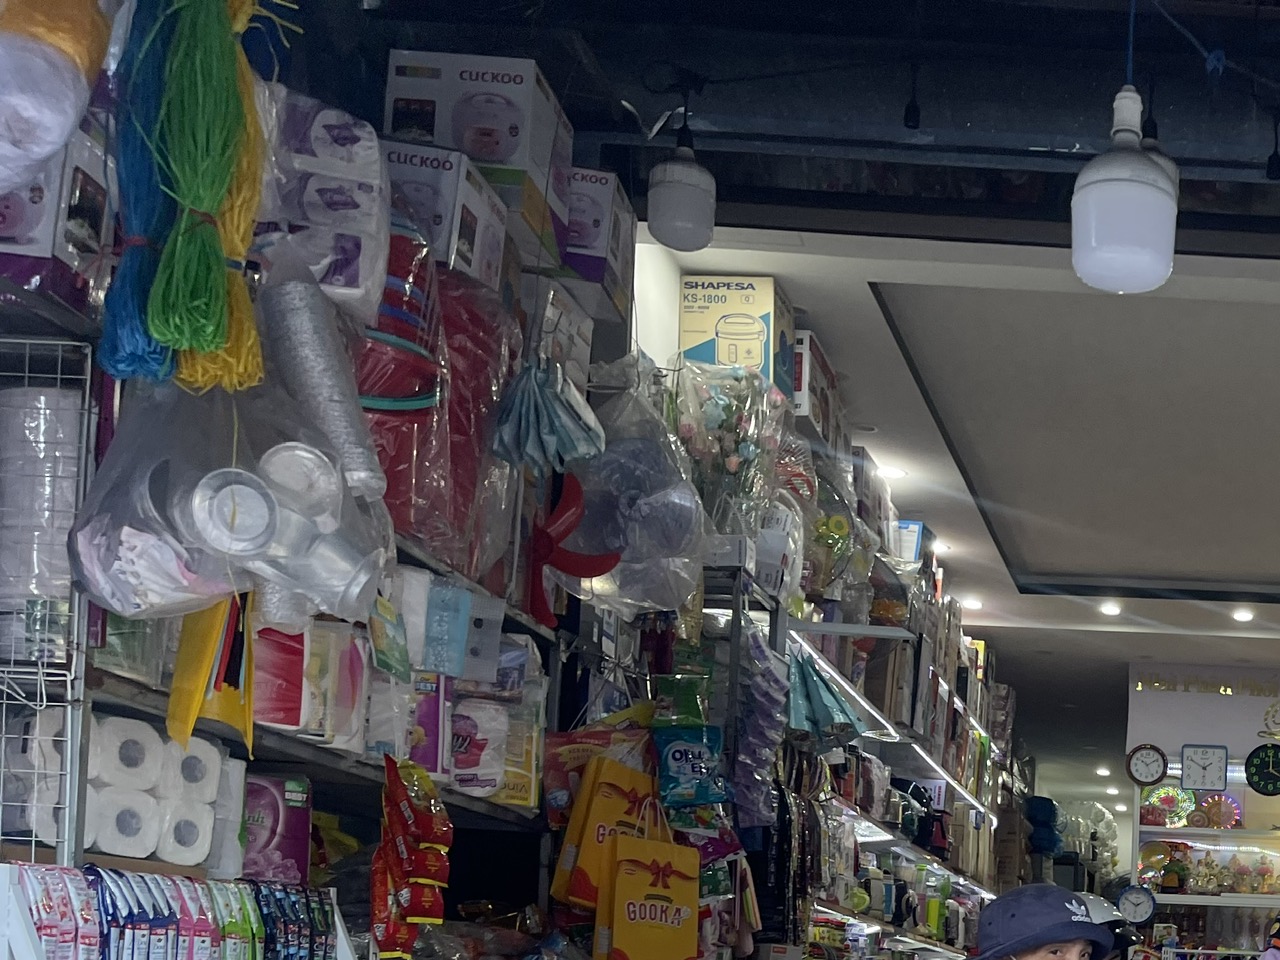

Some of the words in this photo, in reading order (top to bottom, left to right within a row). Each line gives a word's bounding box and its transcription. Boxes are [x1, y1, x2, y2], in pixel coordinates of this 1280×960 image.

[459, 69, 524, 85] CUCKOO
[387, 150, 453, 171] CUCKOO
[683, 281, 756, 291] SHAPESA
[683, 293, 727, 303] KS-1800
[626, 902, 681, 927] GOOKA
